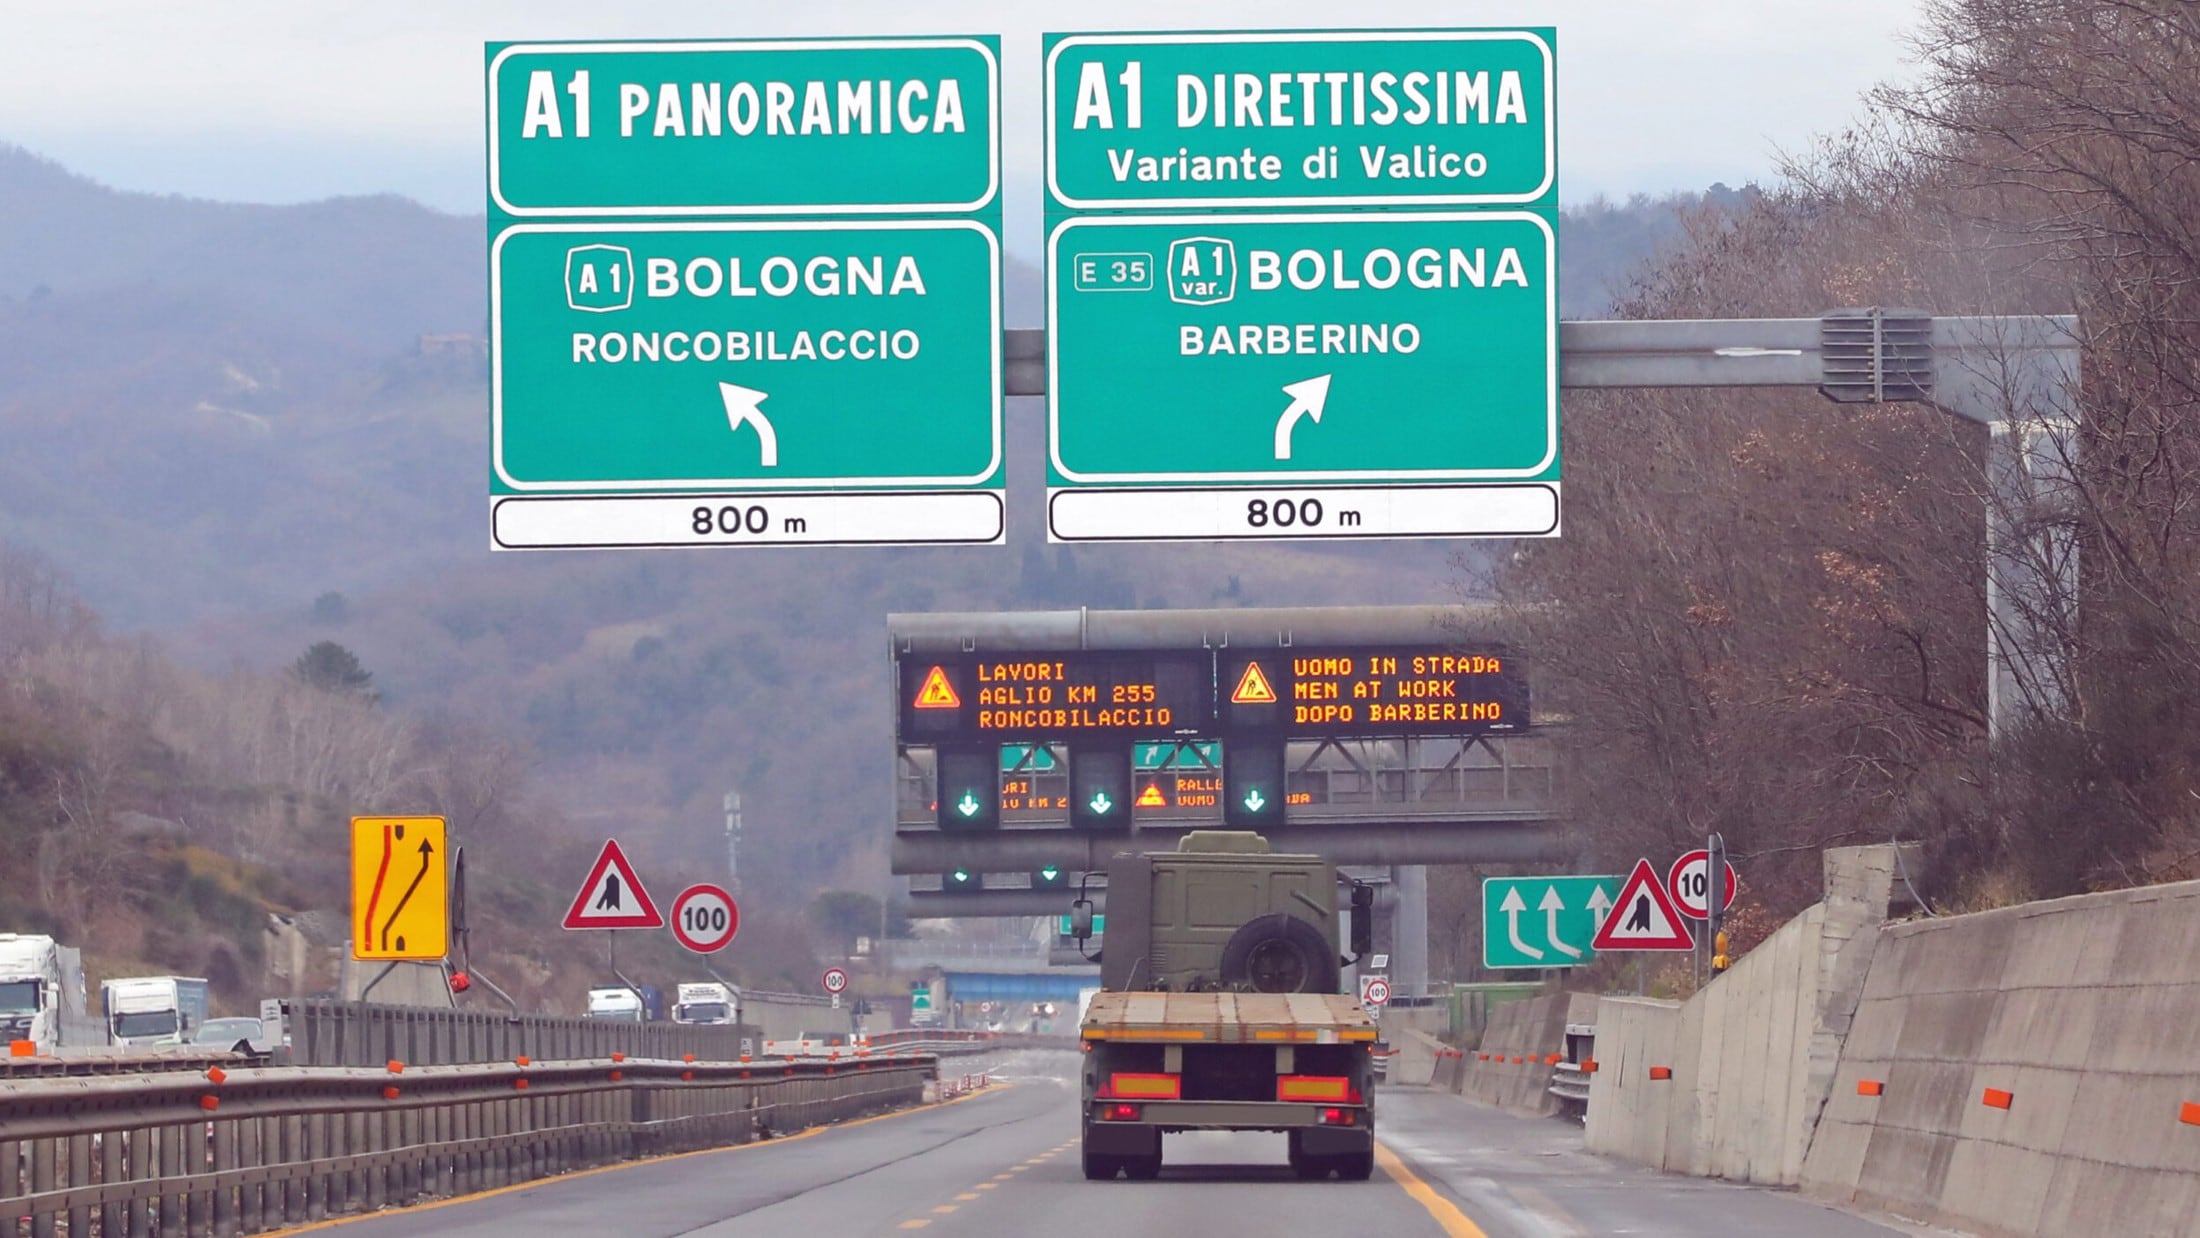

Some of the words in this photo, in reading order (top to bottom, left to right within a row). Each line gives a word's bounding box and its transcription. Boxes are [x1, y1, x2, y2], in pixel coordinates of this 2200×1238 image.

[522, 70, 590, 138] A1
[620, 79, 965, 137] PANORAMICA
[1073, 61, 1141, 129] A1
[1177, 71, 1527, 127] DIRETTISSIMA
[1108, 148, 1281, 181] Variante
[1303, 146, 1337, 179] di
[1360, 145, 1487, 178] Valico
[647, 256, 926, 297] BOLOGNA
[1250, 248, 1528, 290] BOLOGNA
[1182, 282, 1222, 295] var.
[573, 330, 919, 362] RONCOBILACCIO
[1181, 323, 1420, 355] BARBERINO
[693, 506, 768, 534] 800
[785, 519, 805, 532] m
[1248, 499, 1322, 527] 800
[1340, 511, 1360, 525] m
[979, 663, 1063, 681] LAVORI
[1295, 658, 1352, 676] UOMO
[1371, 658, 1396, 674] IN
[1413, 656, 1500, 674] STRADA
[980, 686, 1051, 704] AGLIO
[1068, 686, 1096, 703] KM
[1113, 685, 1155, 702] 255
[1295, 682, 1338, 699] MEN
[1354, 681, 1381, 698] AT
[1399, 680, 1455, 697] WORK
[980, 709, 1170, 728] RONCOBILACCIO
[1296, 705, 1353, 723] DOPO
[1369, 703, 1500, 721] BARBERINO
[1682, 873, 1707, 897] 10
[684, 907, 725, 931] 100
[828, 976, 843, 987] 100
[1372, 988, 1386, 998] 100
